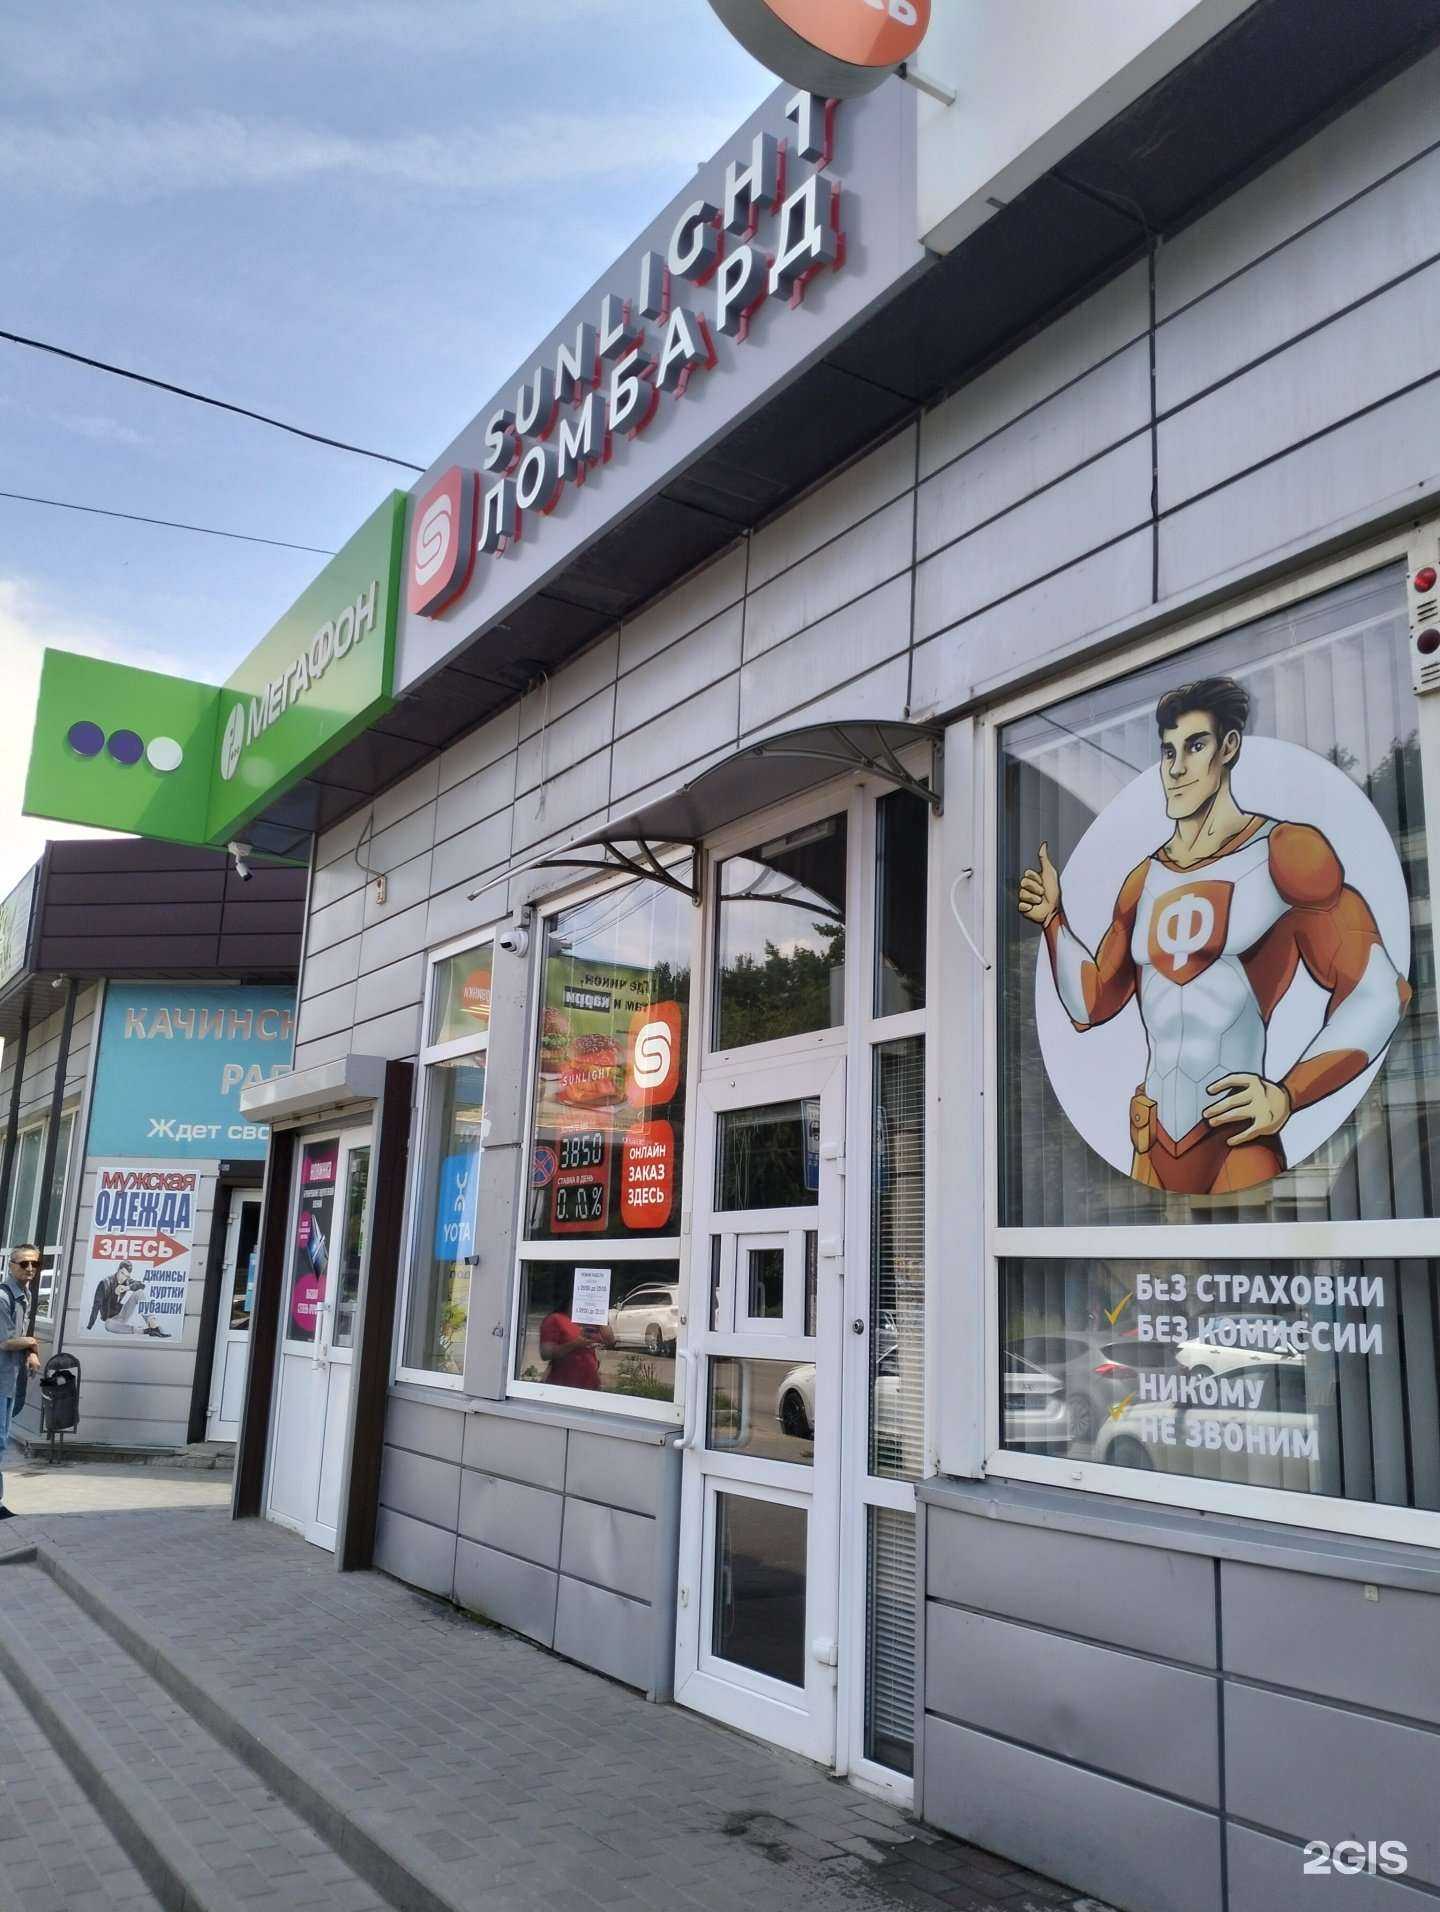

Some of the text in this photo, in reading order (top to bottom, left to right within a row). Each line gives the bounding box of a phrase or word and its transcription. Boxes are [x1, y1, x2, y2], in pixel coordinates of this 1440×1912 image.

[479, 174, 828, 551] ЛОМБАРД
[247, 579, 378, 746] МЕГАФОН
[1157, 893, 1214, 971] Ф
[562, 1068, 611, 1087] SUNLIGHT
[147, 1118, 221, 1142] Ждет
[561, 1133, 602, 1168] 3850
[629, 1143, 666, 1159] ОНЛАЙН
[580, 1174, 594, 1184] ДЕНЬ
[628, 1164, 665, 1182] ЗАКАЗ
[628, 1188, 665, 1206] ЗДЕСЬ
[95, 1191, 191, 1234] ОДЕЖДА
[443, 1222, 471, 1243] YOTA
[99, 1238, 173, 1259] ЗДЕСЬ
[143, 1269, 186, 1283] джинсы
[150, 1286, 184, 1299] куртки
[1135, 1273, 1385, 1308] БЕЗ СТРАХОВКИ
[138, 1301, 183, 1315] рубашки
[1137, 1314, 1383, 1355] БЕЗ КОМИССИИ
[1138, 1373, 1264, 1408] НИКОМУ
[1141, 1416, 1320, 1460] НЕ ЗВОНИМ
